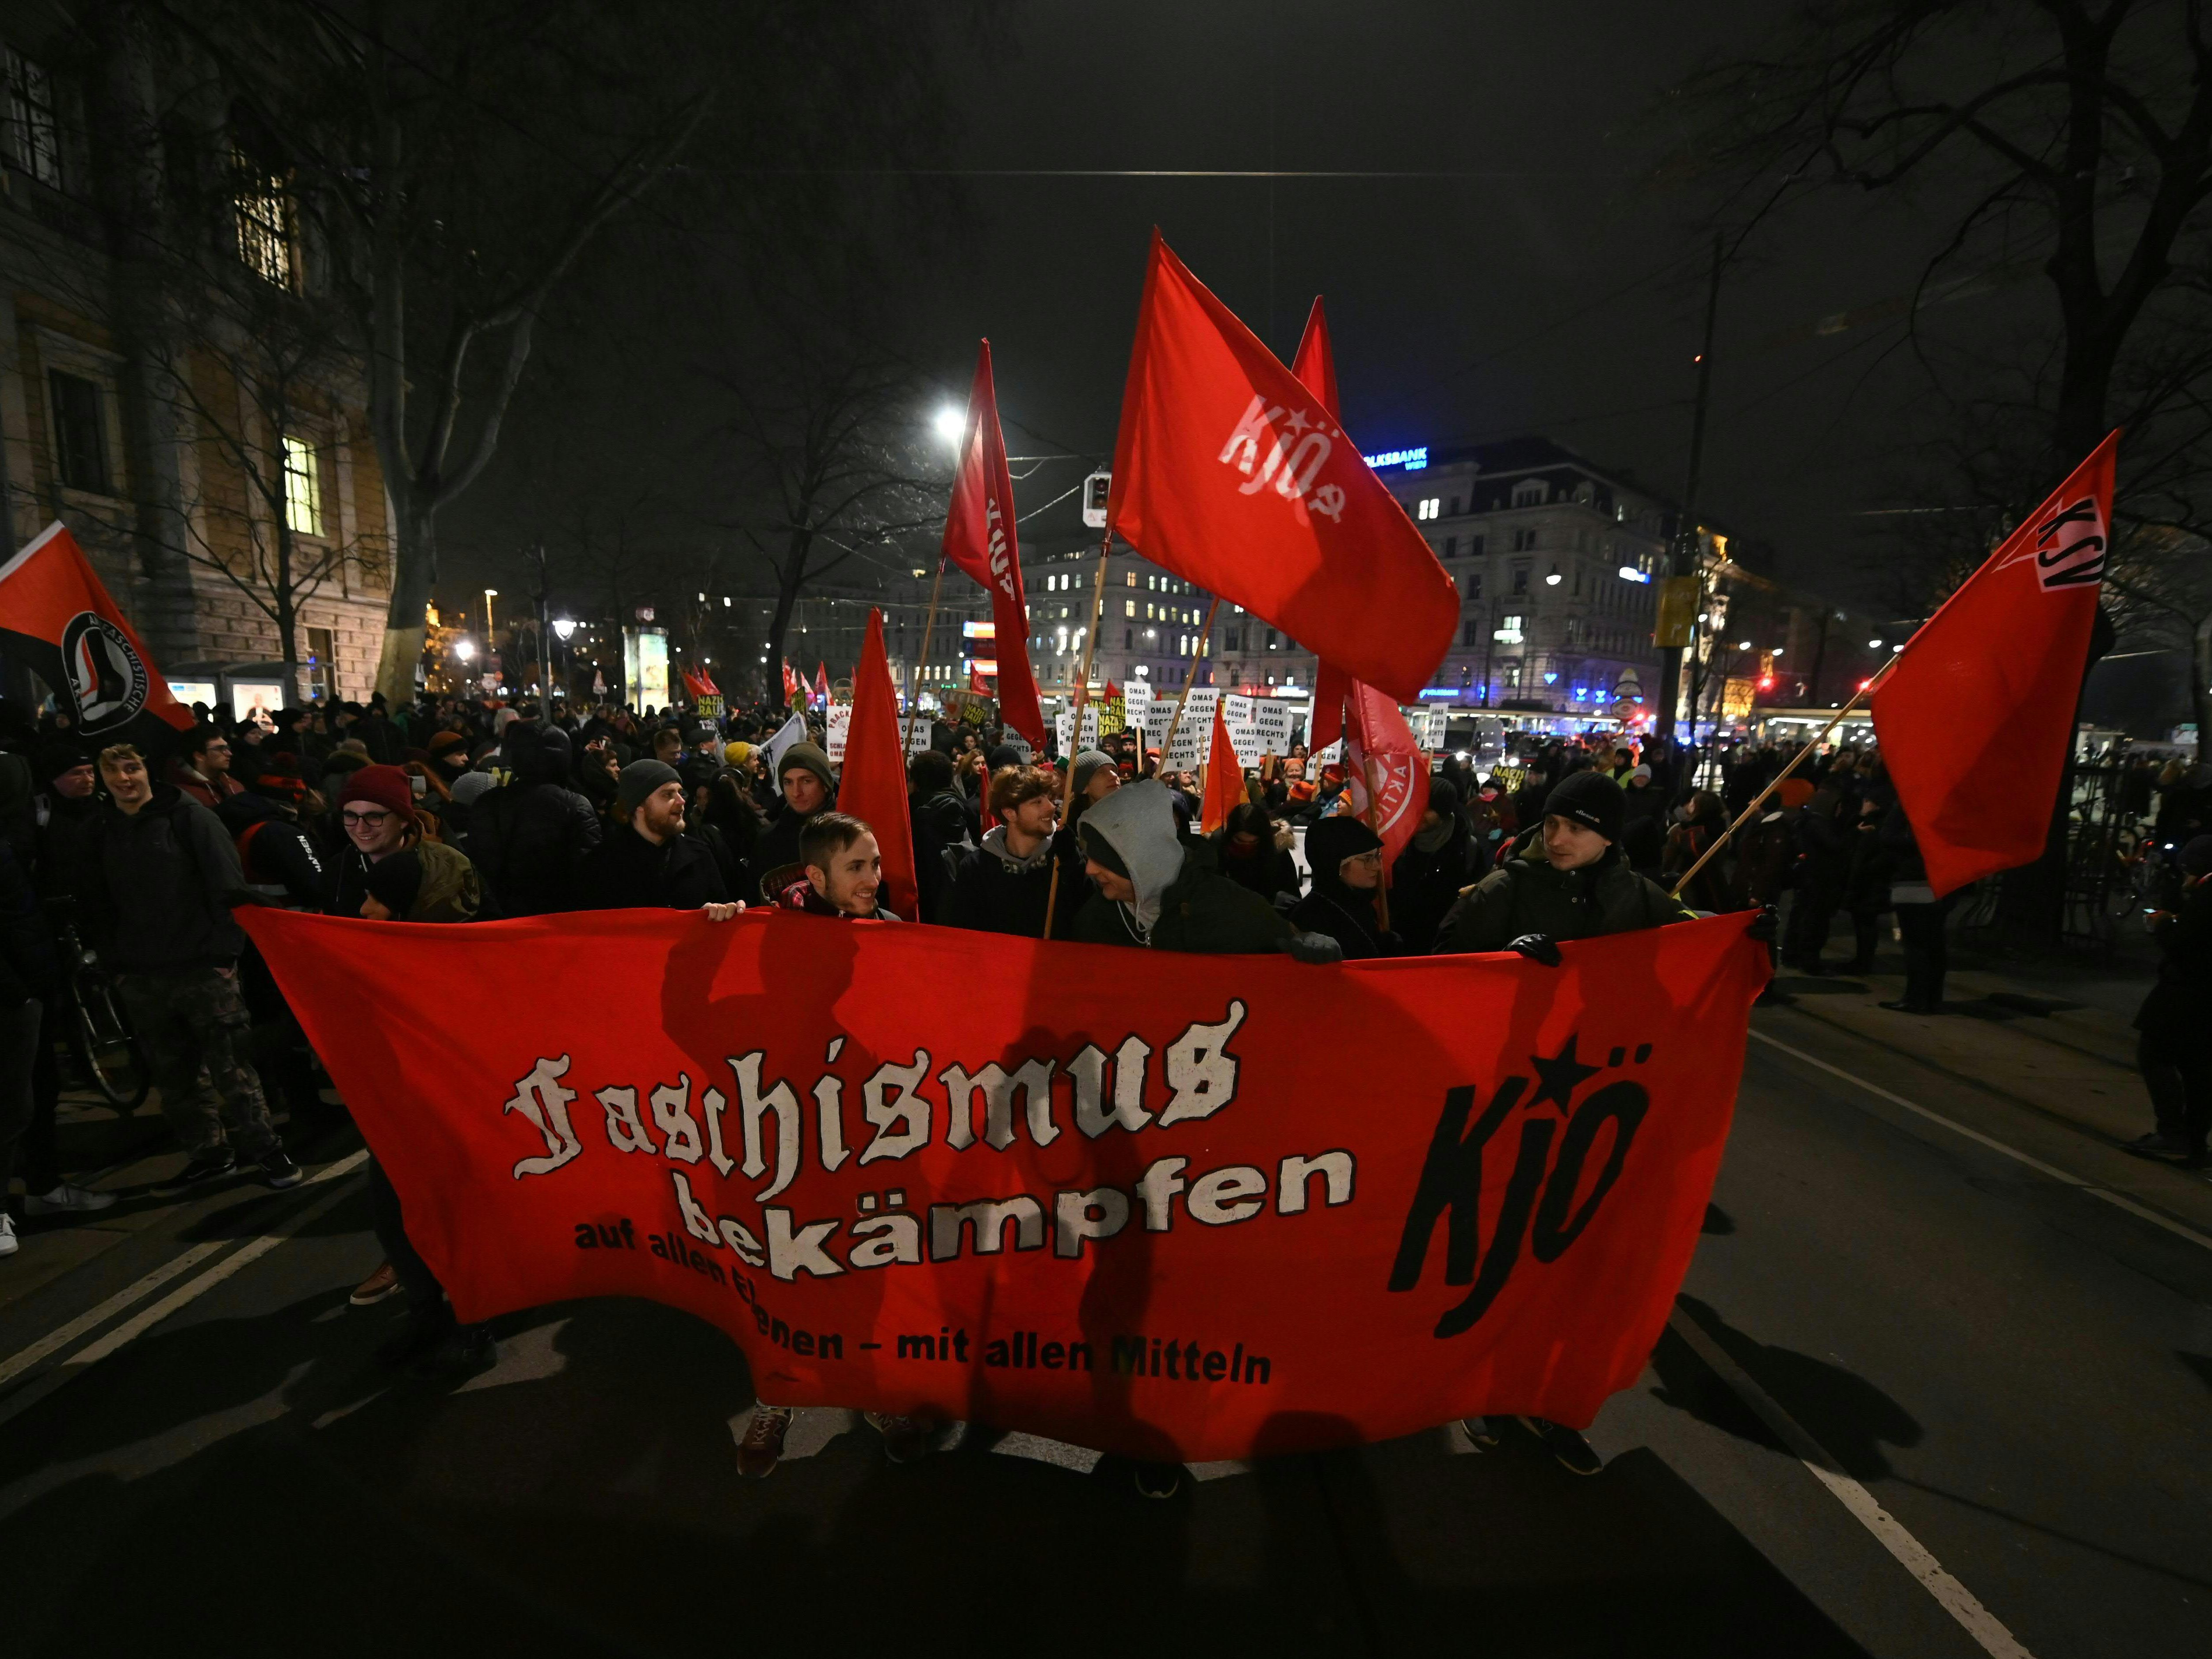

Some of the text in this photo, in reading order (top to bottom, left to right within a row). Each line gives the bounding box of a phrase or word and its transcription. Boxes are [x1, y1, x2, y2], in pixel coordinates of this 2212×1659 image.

[1364, 447, 1427, 468] OLKSBANK
[1405, 460, 1427, 470] WIEN
[1110, 697, 1125, 707] NAZ
[1110, 706, 1126, 717] RAU
[1257, 730, 1284, 738] RECHTS
[296, 835, 322, 872] HANSEN
[669, 1149, 1358, 1282] bekämpfen
[575, 1218, 636, 1250] auf
[648, 1232, 728, 1286] allen
[897, 1326, 969, 1362] mit
[986, 1332, 1093, 1372] allen
[1111, 1335, 1271, 1384] Mitteln
